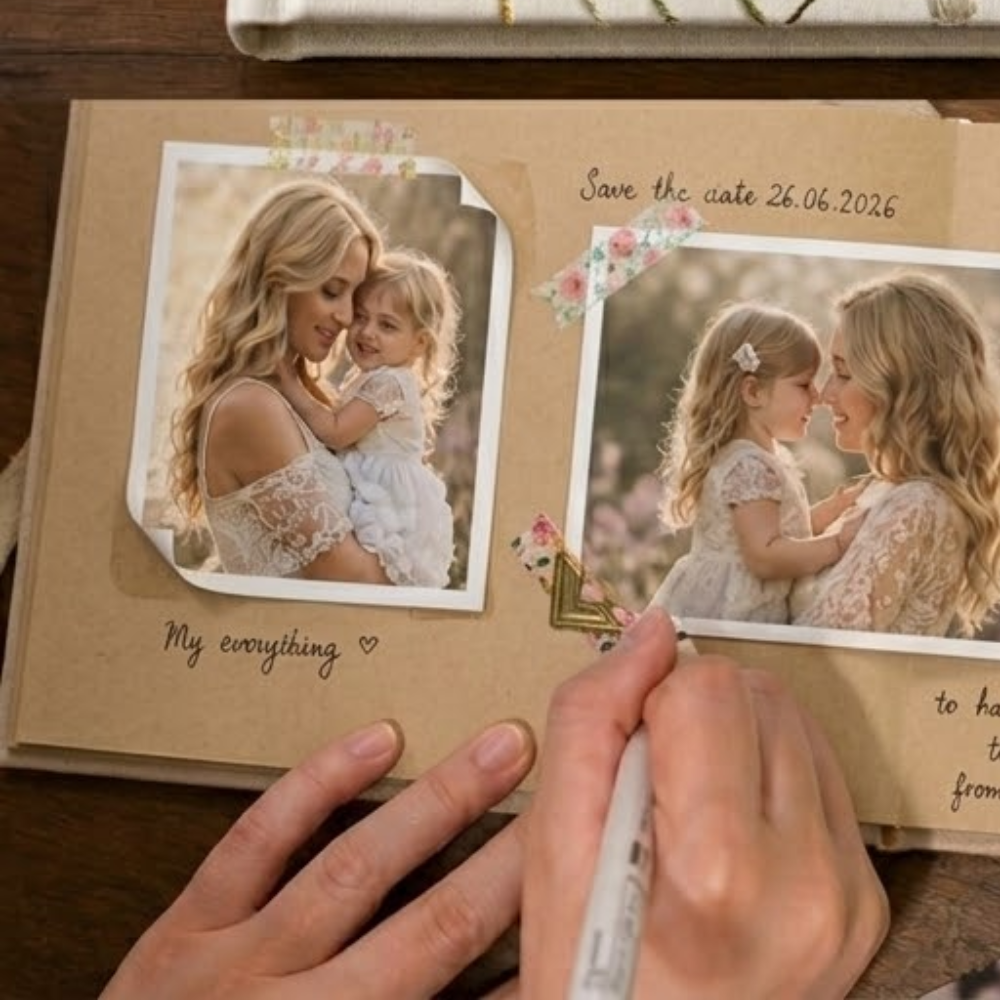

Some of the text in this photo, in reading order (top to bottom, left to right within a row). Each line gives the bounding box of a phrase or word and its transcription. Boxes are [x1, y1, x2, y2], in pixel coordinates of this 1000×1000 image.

[579, 166, 638, 202] Save
[765, 182, 899, 220] 26.06.2026
[163, 620, 205, 669] My
[934, 690, 959, 716] to
